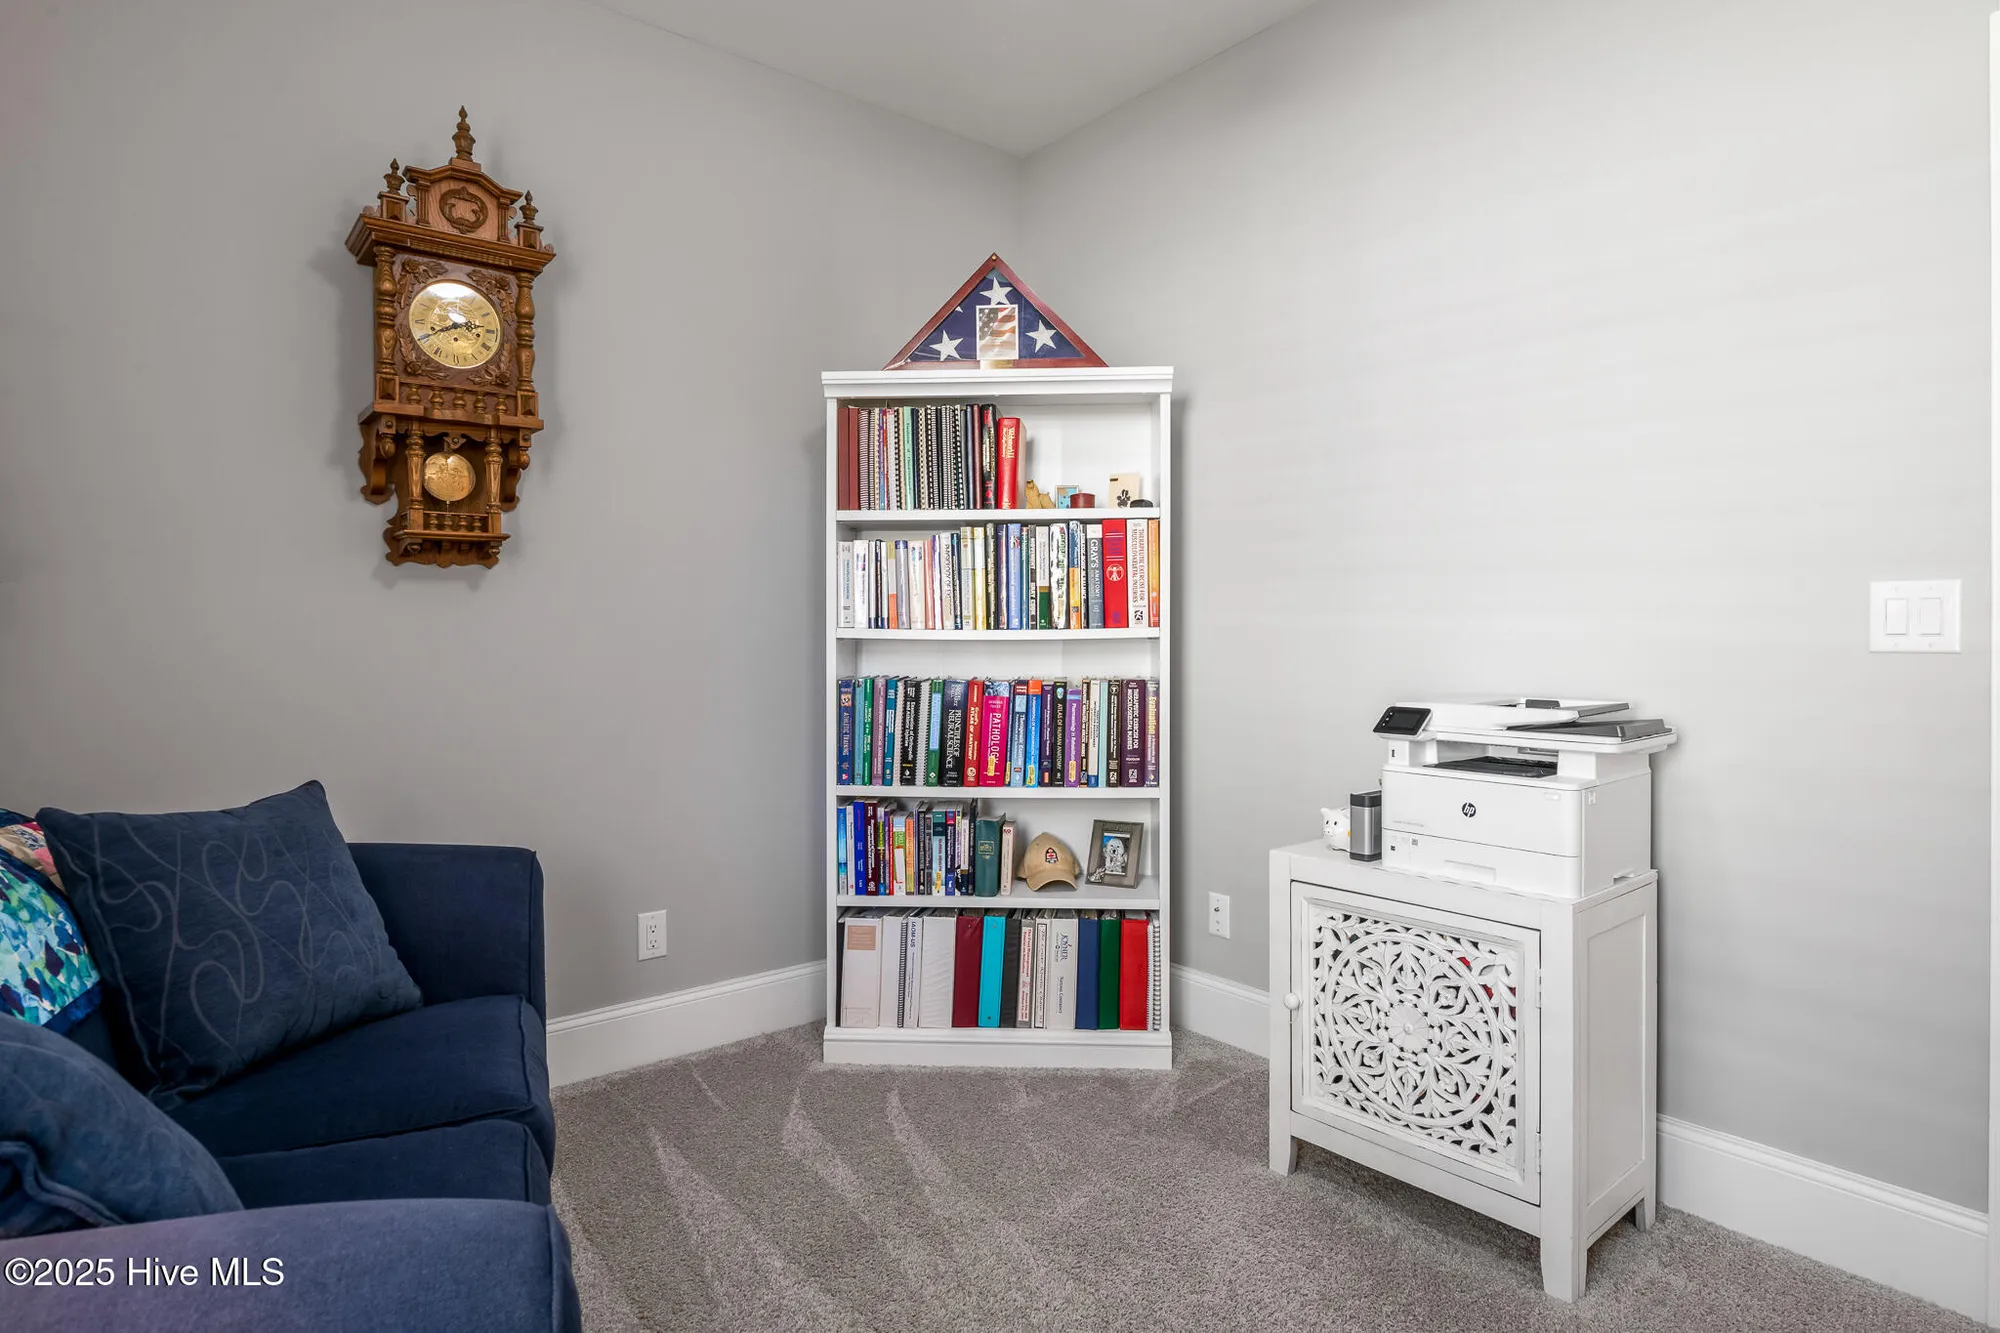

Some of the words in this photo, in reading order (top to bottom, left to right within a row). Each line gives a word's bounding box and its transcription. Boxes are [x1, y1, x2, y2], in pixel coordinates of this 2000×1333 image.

[1090, 539, 1099, 568] GRAY'S
[1148, 697, 1157, 734] Evaluation
[946, 740, 954, 768] SCIENCE
[953, 748, 960, 757] OF
[1462, 802, 1476, 818] hp
[1060, 933, 1069, 961] JOYNER
